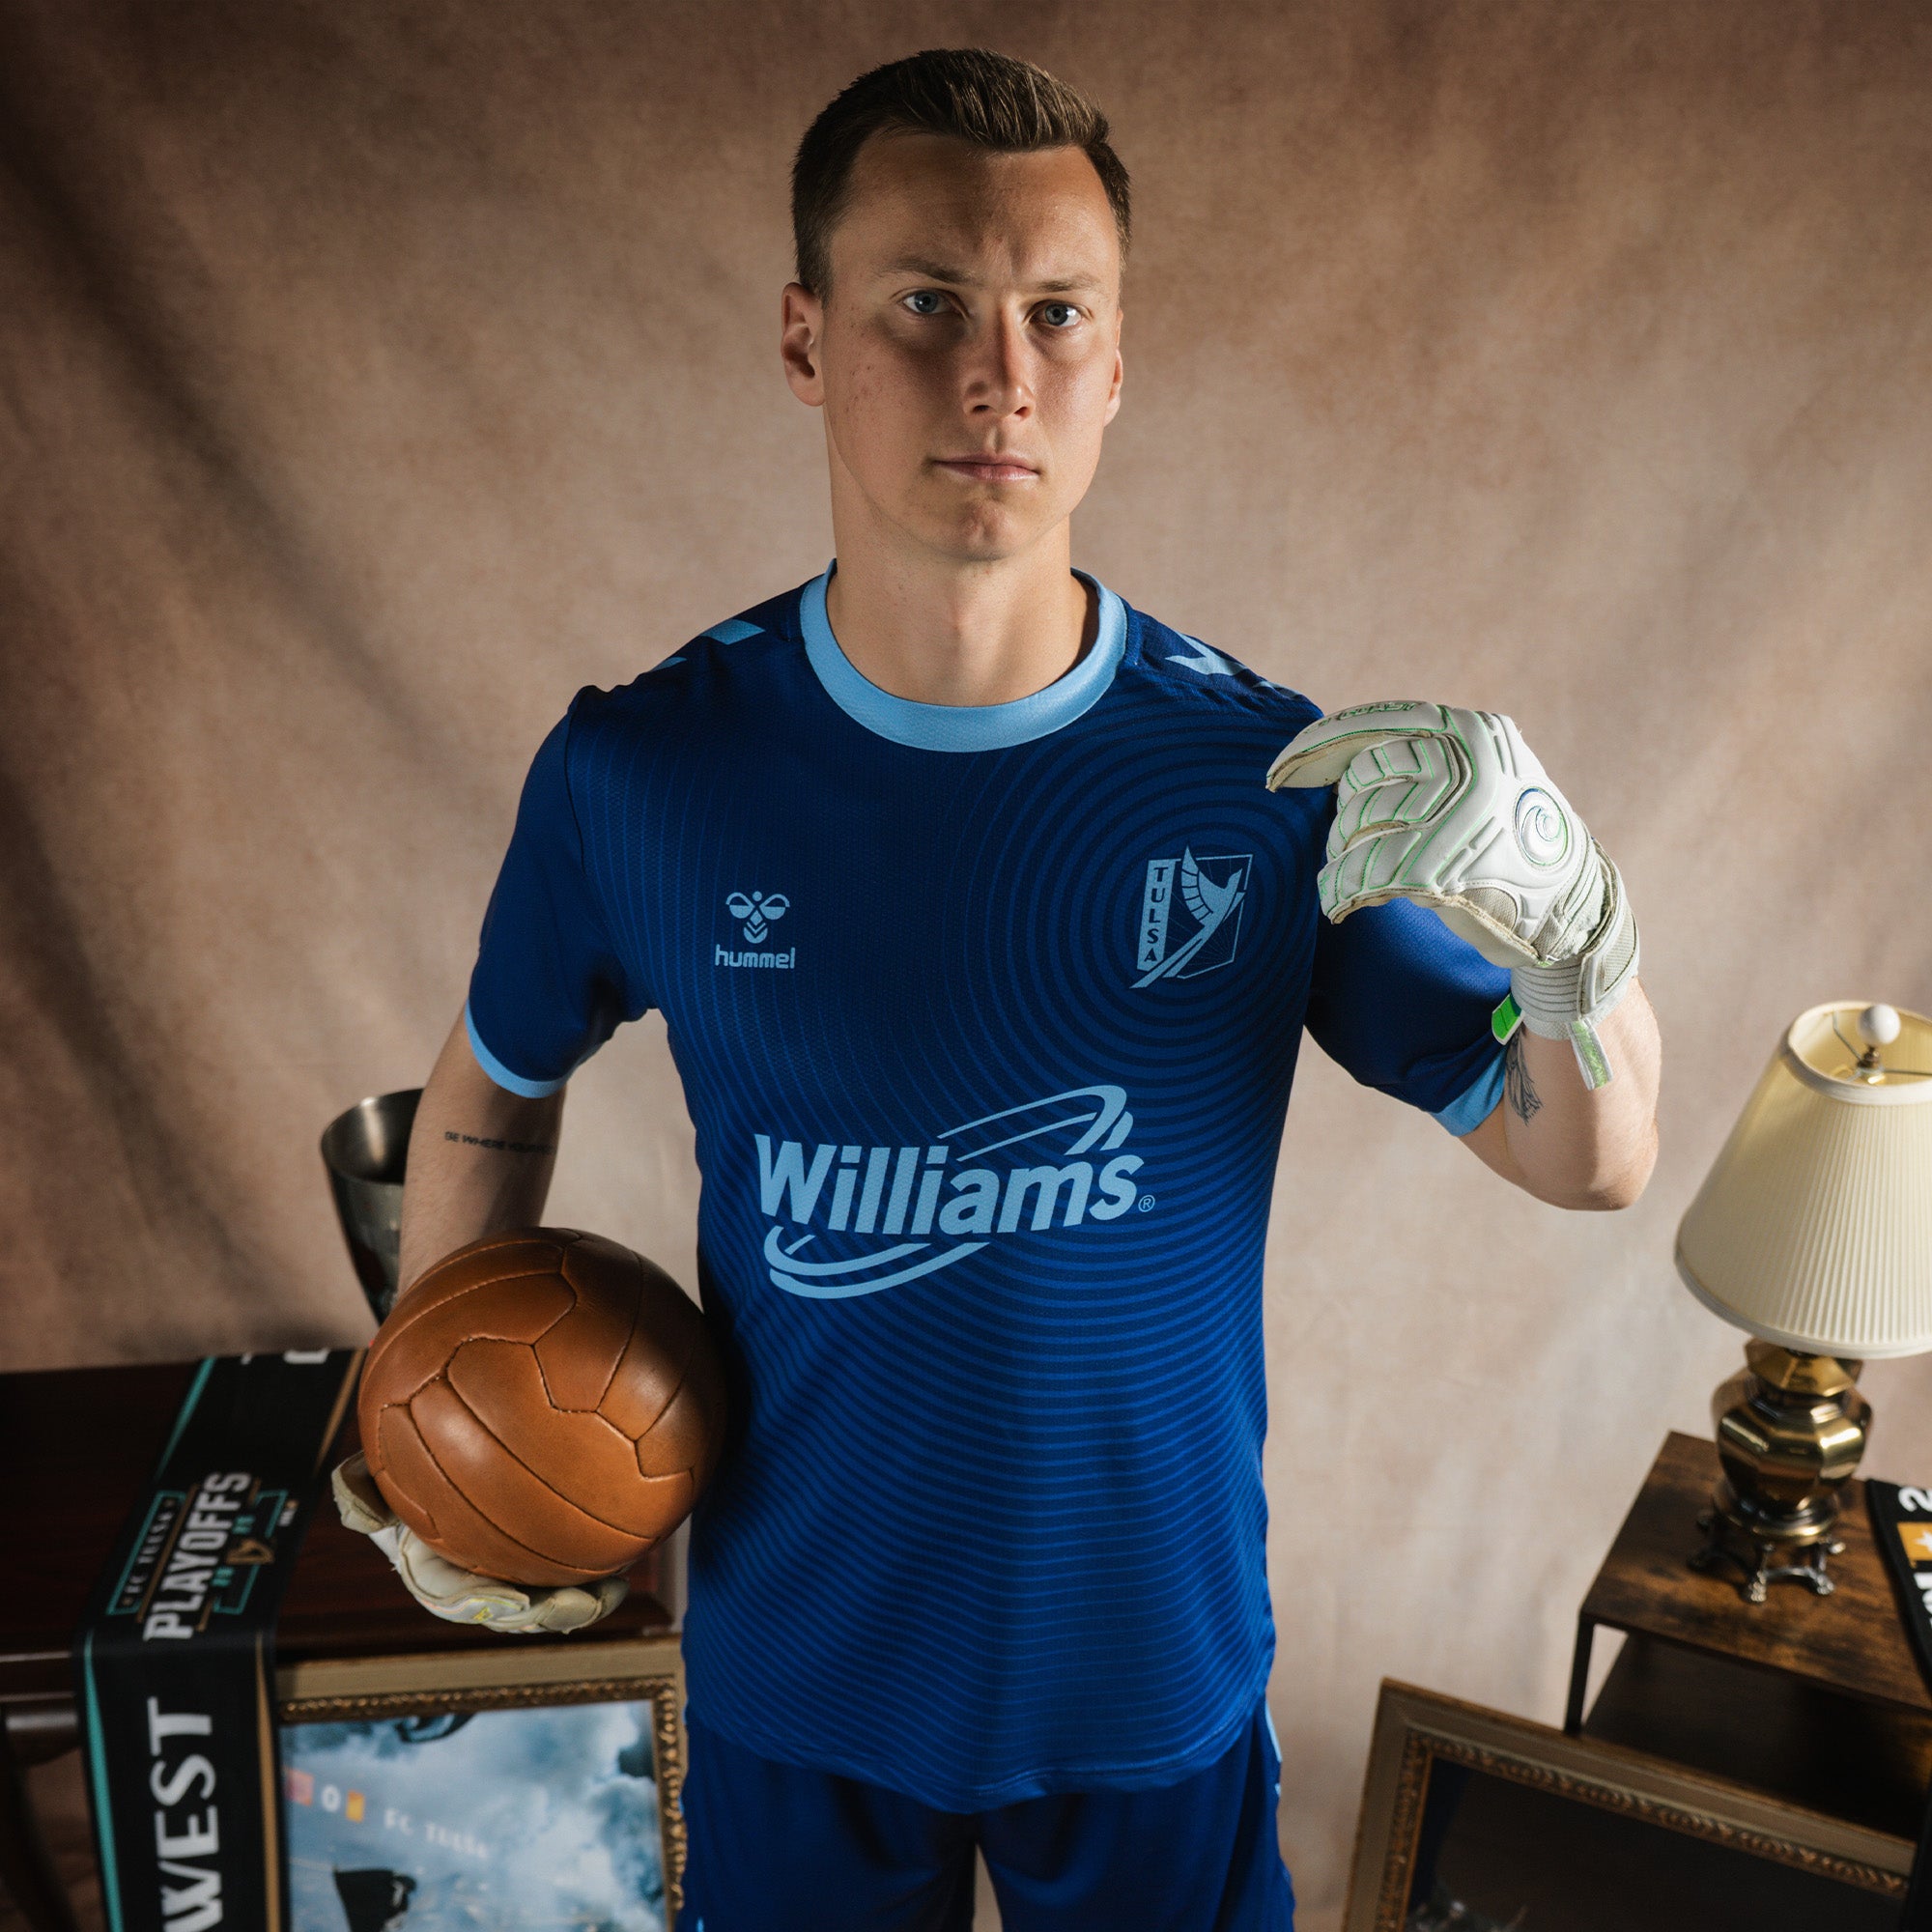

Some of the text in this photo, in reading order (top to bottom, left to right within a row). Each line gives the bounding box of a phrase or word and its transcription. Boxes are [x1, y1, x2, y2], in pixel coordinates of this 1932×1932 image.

[714, 943, 796, 970] hummel
[1143, 866, 1170, 963] TULSA
[753, 1132, 1145, 1236] Williams
[143, 1471, 252, 1641] PLAYOFFS
[147, 1695, 223, 1932] WEST
